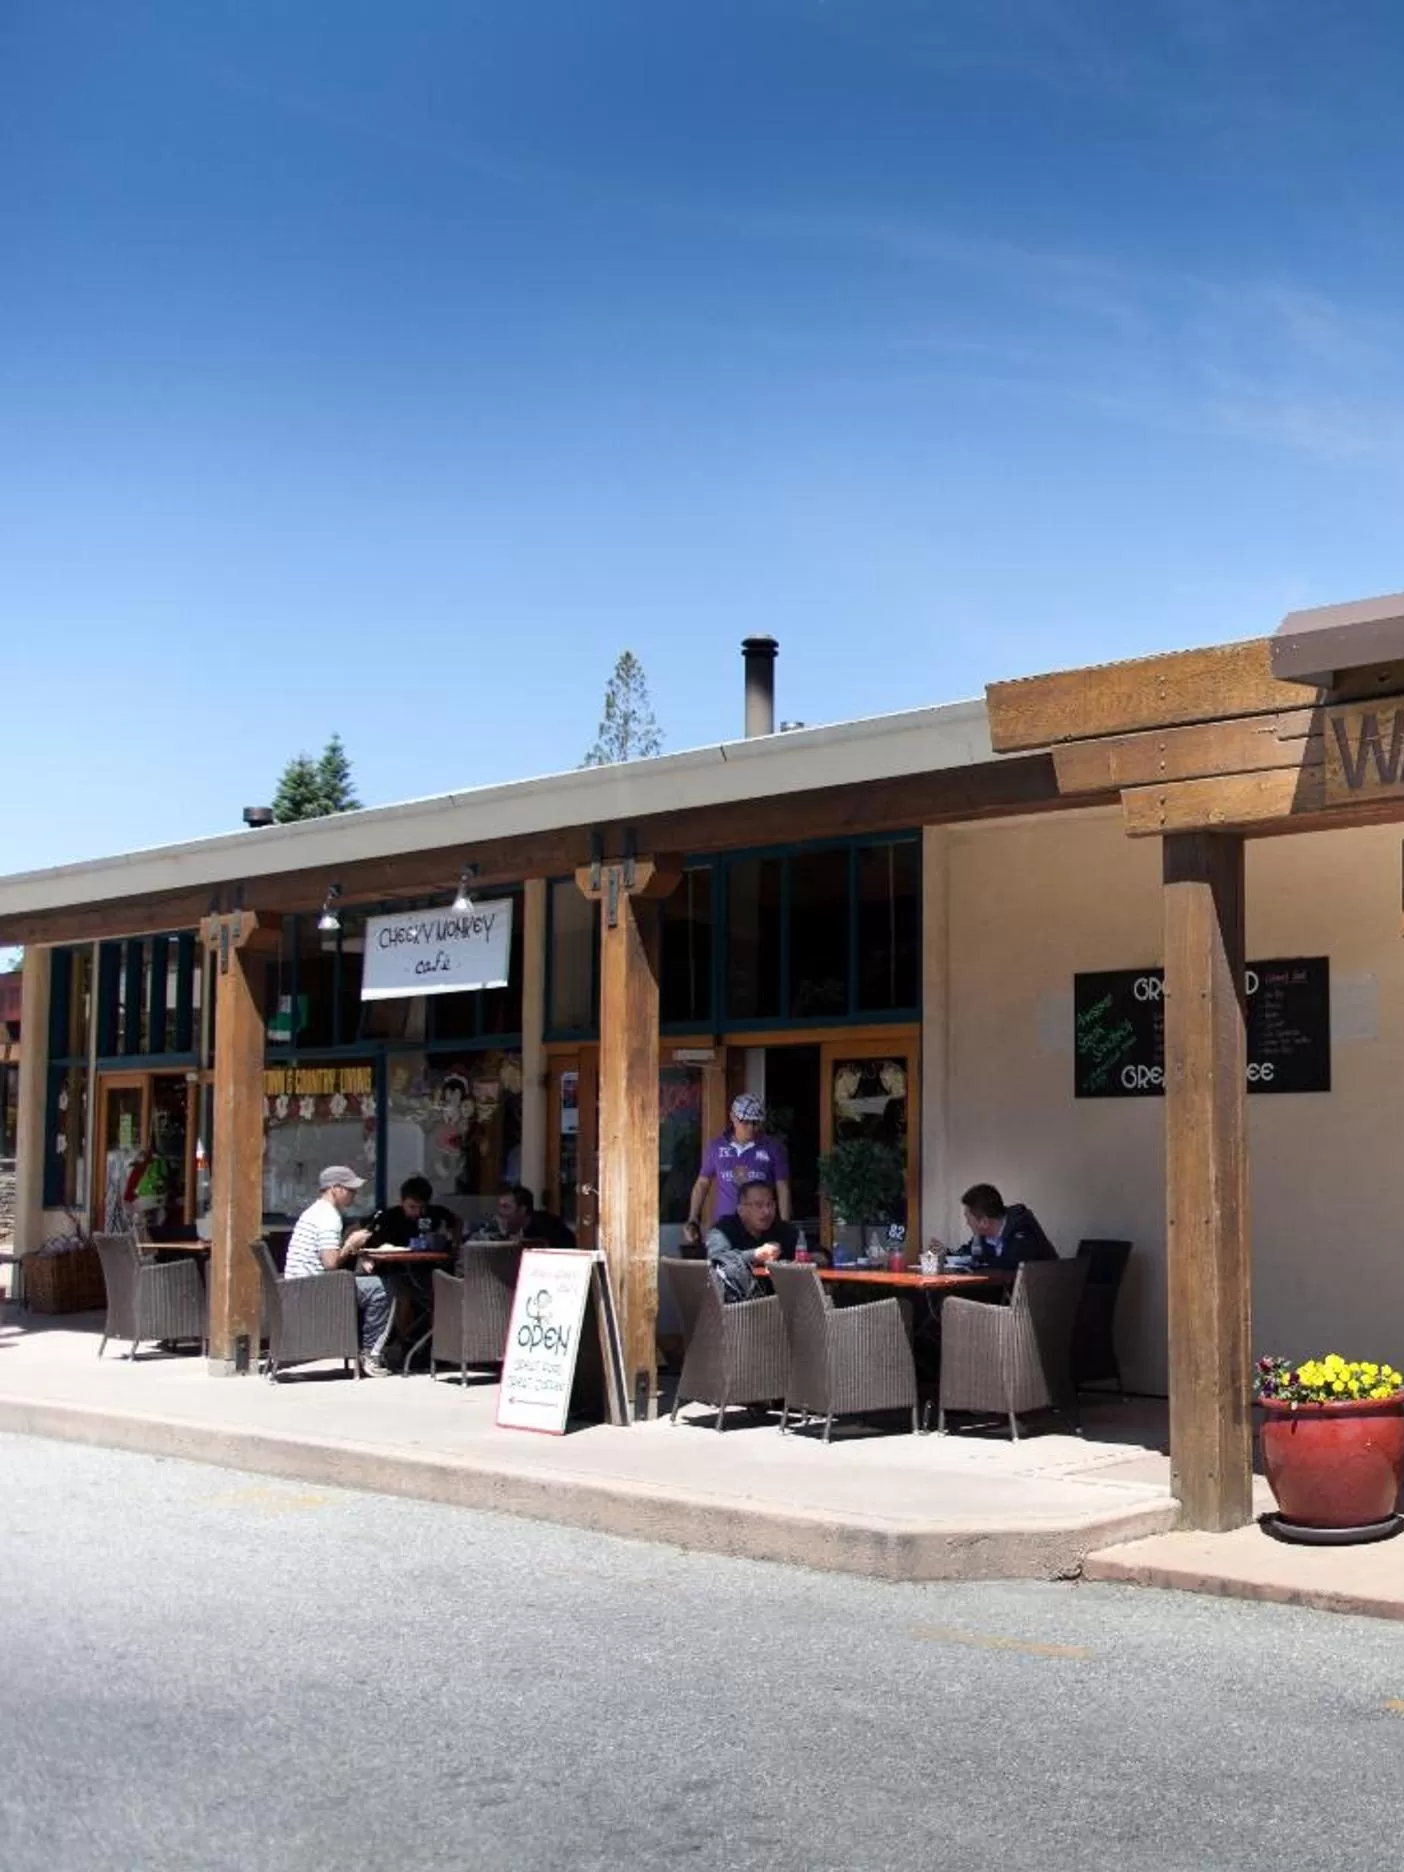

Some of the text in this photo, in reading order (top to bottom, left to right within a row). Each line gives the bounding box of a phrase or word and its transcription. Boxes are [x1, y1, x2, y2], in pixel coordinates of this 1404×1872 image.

[378, 913, 496, 948] CHEEKY MONKEY
[1121, 1064, 1166, 1089] GRE
[517, 1324, 572, 1356] OPEN
